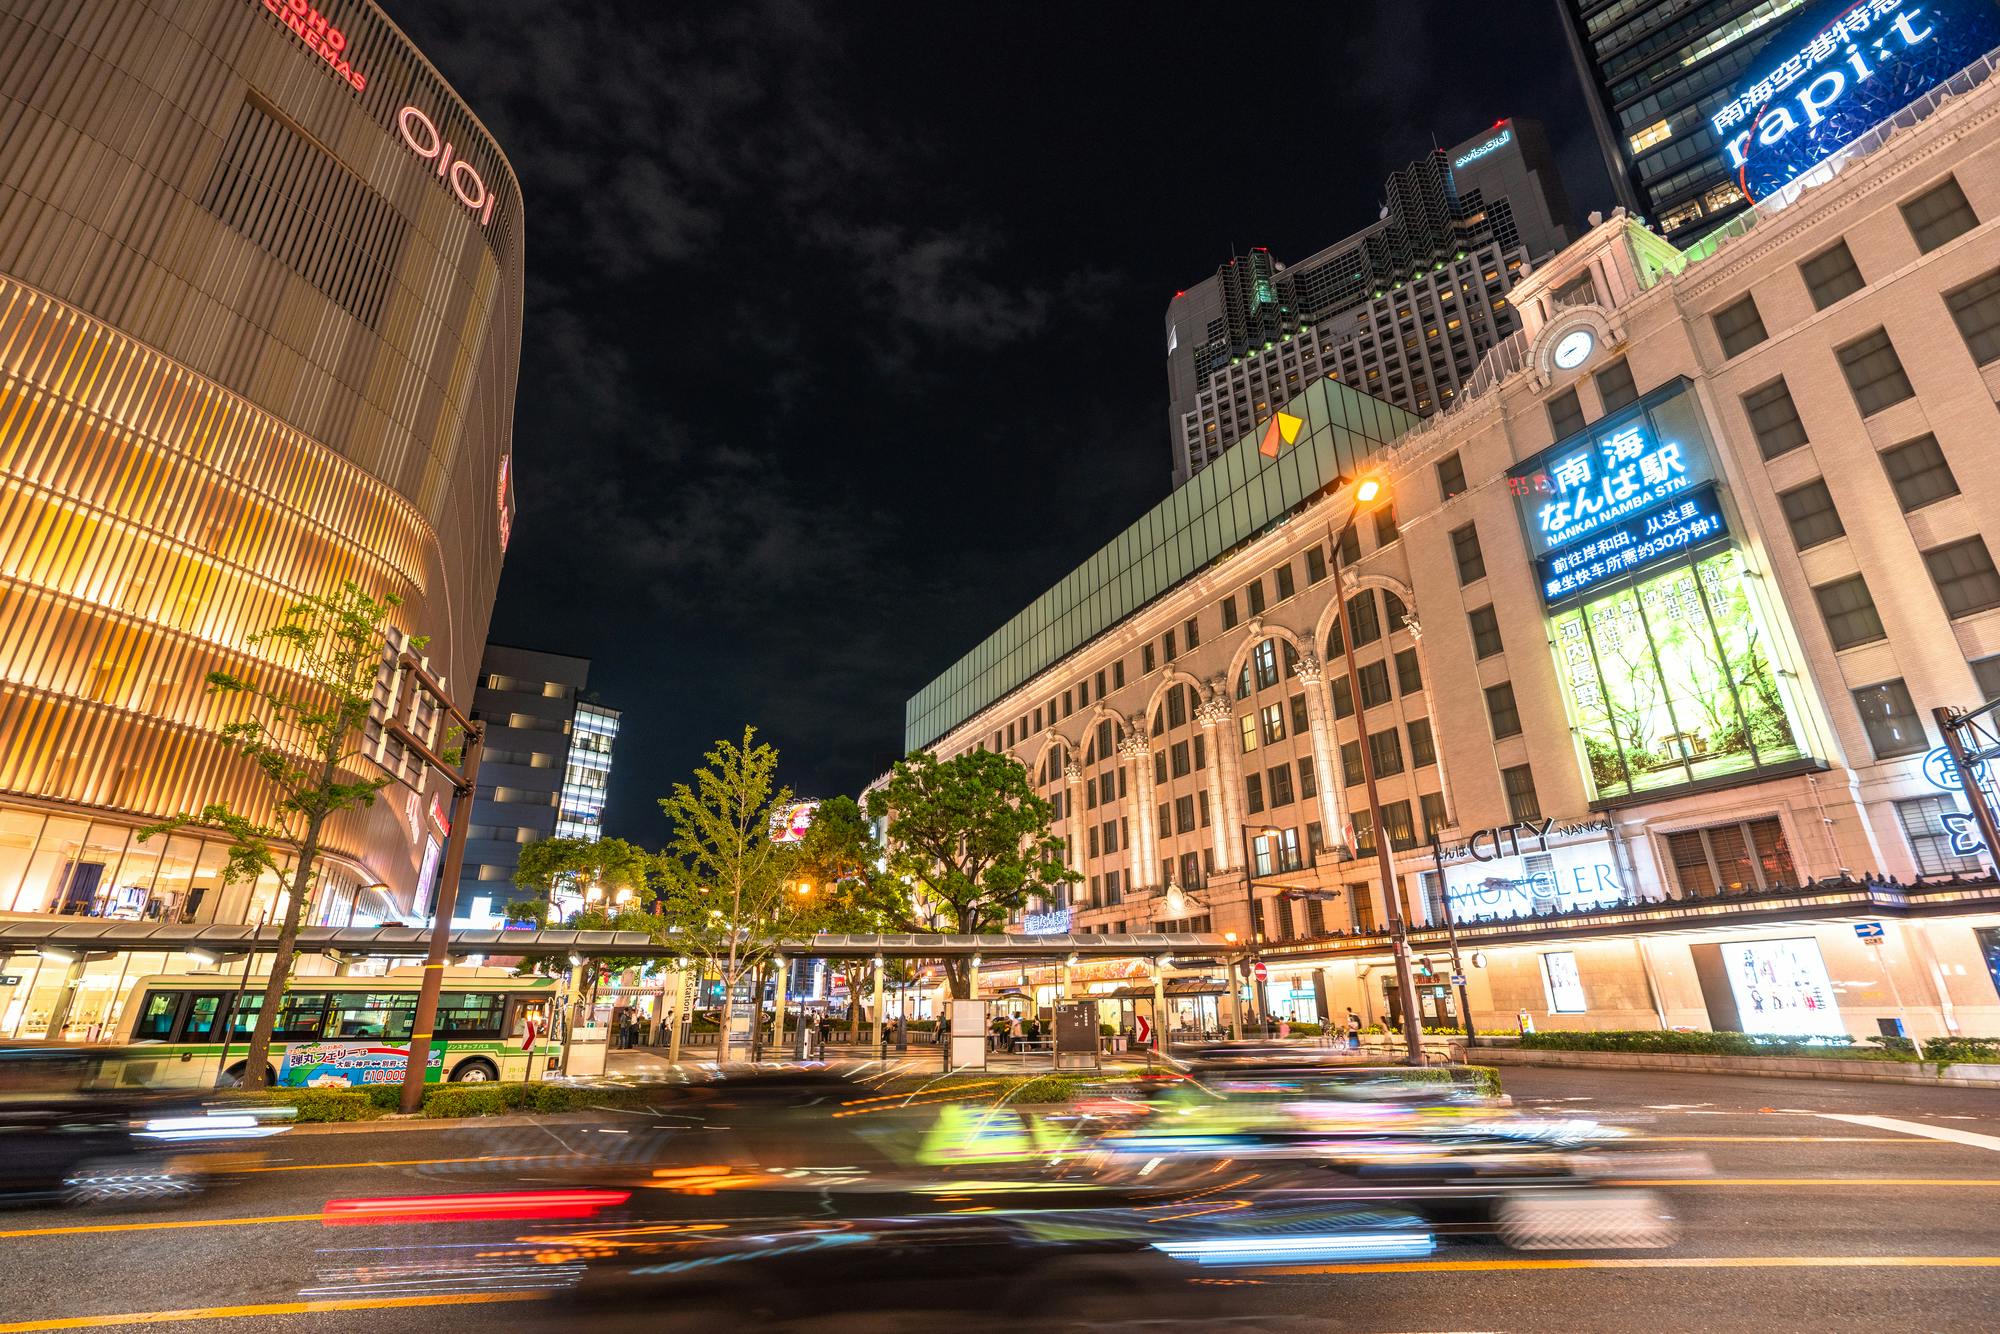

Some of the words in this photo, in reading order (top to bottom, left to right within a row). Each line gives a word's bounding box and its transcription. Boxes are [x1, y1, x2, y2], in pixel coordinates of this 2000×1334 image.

[264, 0, 367, 93] CINEMAS
[286, 0, 347, 52] OHO
[1711, 0, 1904, 136] 南海空港特急
[398, 106, 495, 226] OIOI
[1538, 443, 1686, 532] なんば駅
[1553, 425, 1645, 495] 南海
[1547, 509, 1599, 546] NANKAI
[1599, 493, 1654, 526] NAMBA
[1654, 477, 1691, 499] STN.
[1559, 617, 1600, 709] 河内長野
[1470, 817, 1555, 863] CITY
[1559, 819, 1614, 838] NANKAI
[1450, 864, 1620, 909] MONCLER
[683, 983, 695, 1012] Station
